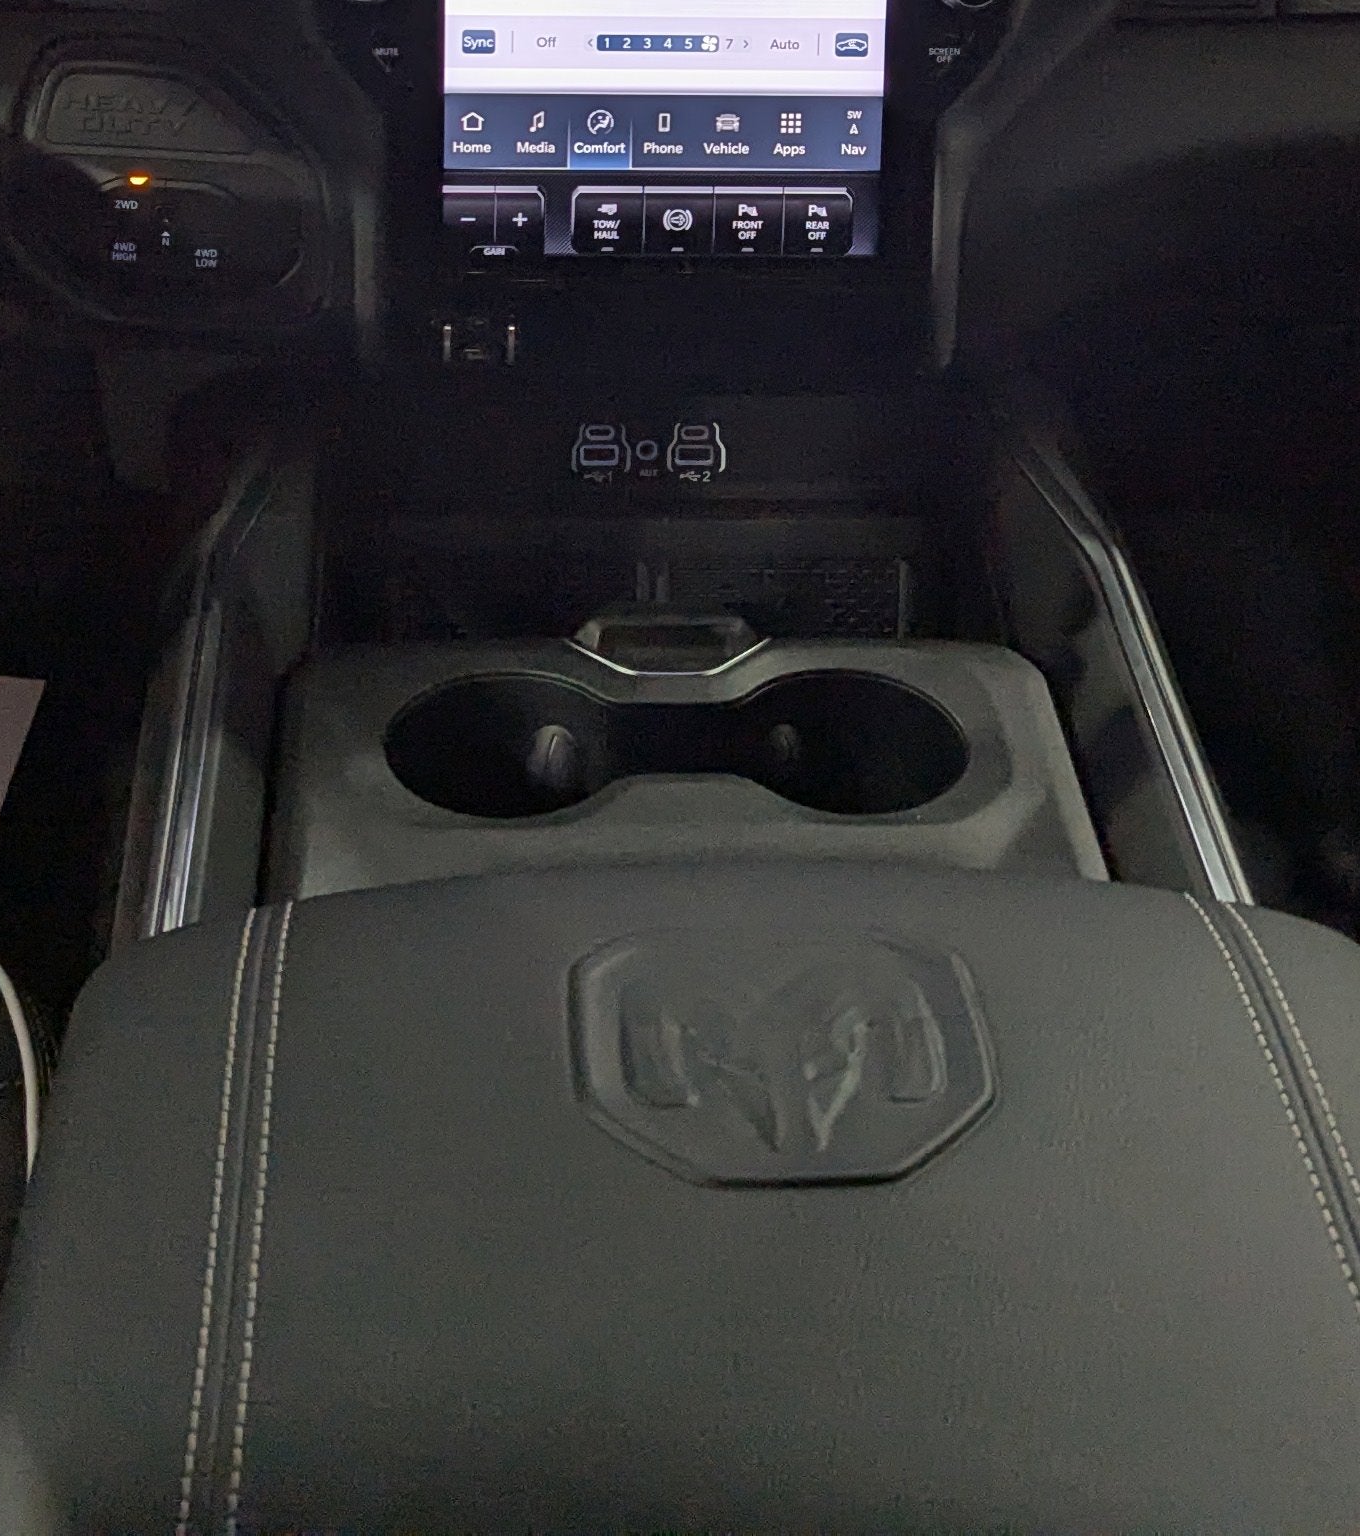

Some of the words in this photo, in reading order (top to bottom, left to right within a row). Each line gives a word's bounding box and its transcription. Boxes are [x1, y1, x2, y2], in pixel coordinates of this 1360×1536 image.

[463, 36, 494, 50] Sync
[536, 37, 557, 48] Off
[604, 38, 610, 48] 1
[622, 38, 630, 49] 2
[643, 38, 651, 49] 3
[664, 38, 672, 49] 4
[685, 38, 693, 49] 5
[725, 39, 733, 50] 7
[770, 39, 800, 51] Auto
[847, 111, 862, 119] SW
[453, 142, 492, 153] Home
[517, 142, 555, 153] Media
[574, 142, 626, 154] Comfort
[643, 143, 683, 154] Phone
[703, 143, 750, 155] Vehicle
[773, 143, 806, 157] Apps
[841, 144, 866, 155] Nav
[115, 200, 138, 210] 2WD
[593, 220, 620, 230] TOW/
[732, 221, 763, 230] FRONT
[806, 221, 829, 230] REAR
[594, 231, 620, 239] HAUL
[738, 232, 756, 240] OFF
[808, 232, 826, 240] OFF
[113, 242, 136, 251] 4WD
[161, 237, 170, 246] N
[112, 252, 137, 261] HIGH
[194, 248, 218, 257] 4WD
[196, 258, 218, 268] LOW
[702, 471, 712, 482] 2
